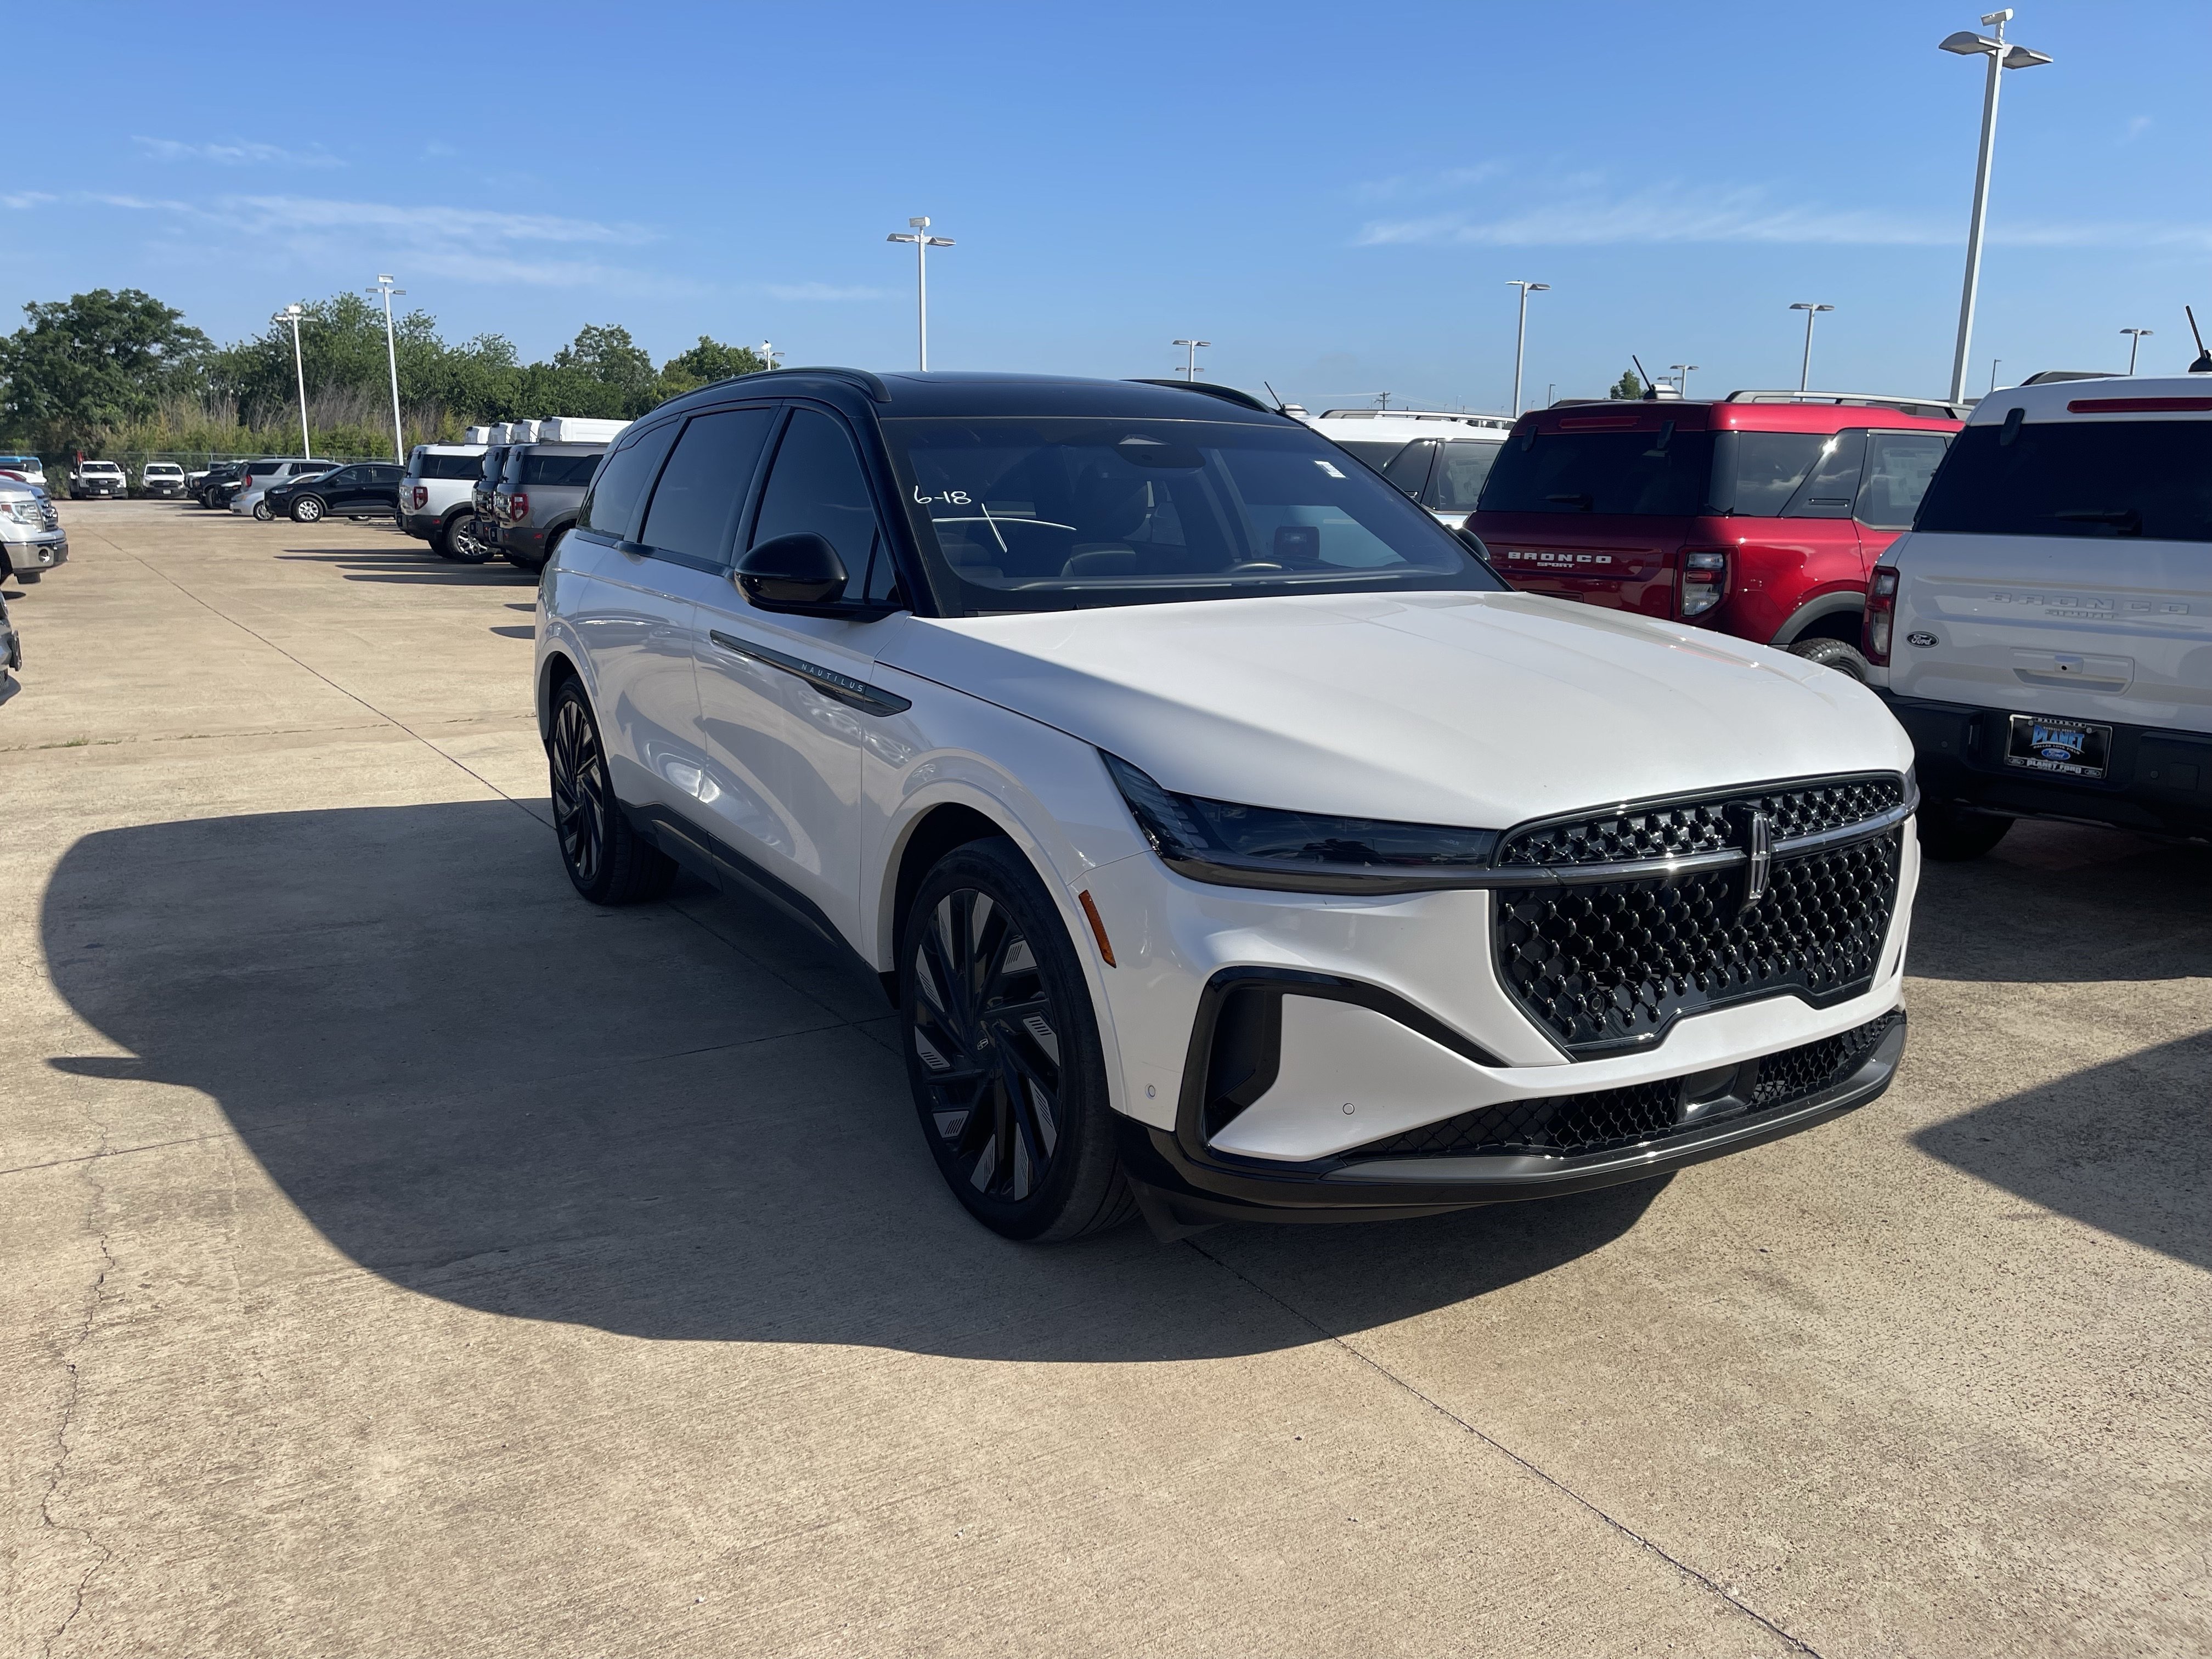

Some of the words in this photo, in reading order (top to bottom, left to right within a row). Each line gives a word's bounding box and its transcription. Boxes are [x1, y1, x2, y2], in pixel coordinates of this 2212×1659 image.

[913, 485, 972, 504] 6-18
[1508, 551, 1612, 564] BRONCO
[1987, 591, 2191, 615] BRONCO
[801, 663, 864, 692] NAUTILUS
[2032, 724, 2085, 751] PLANET
